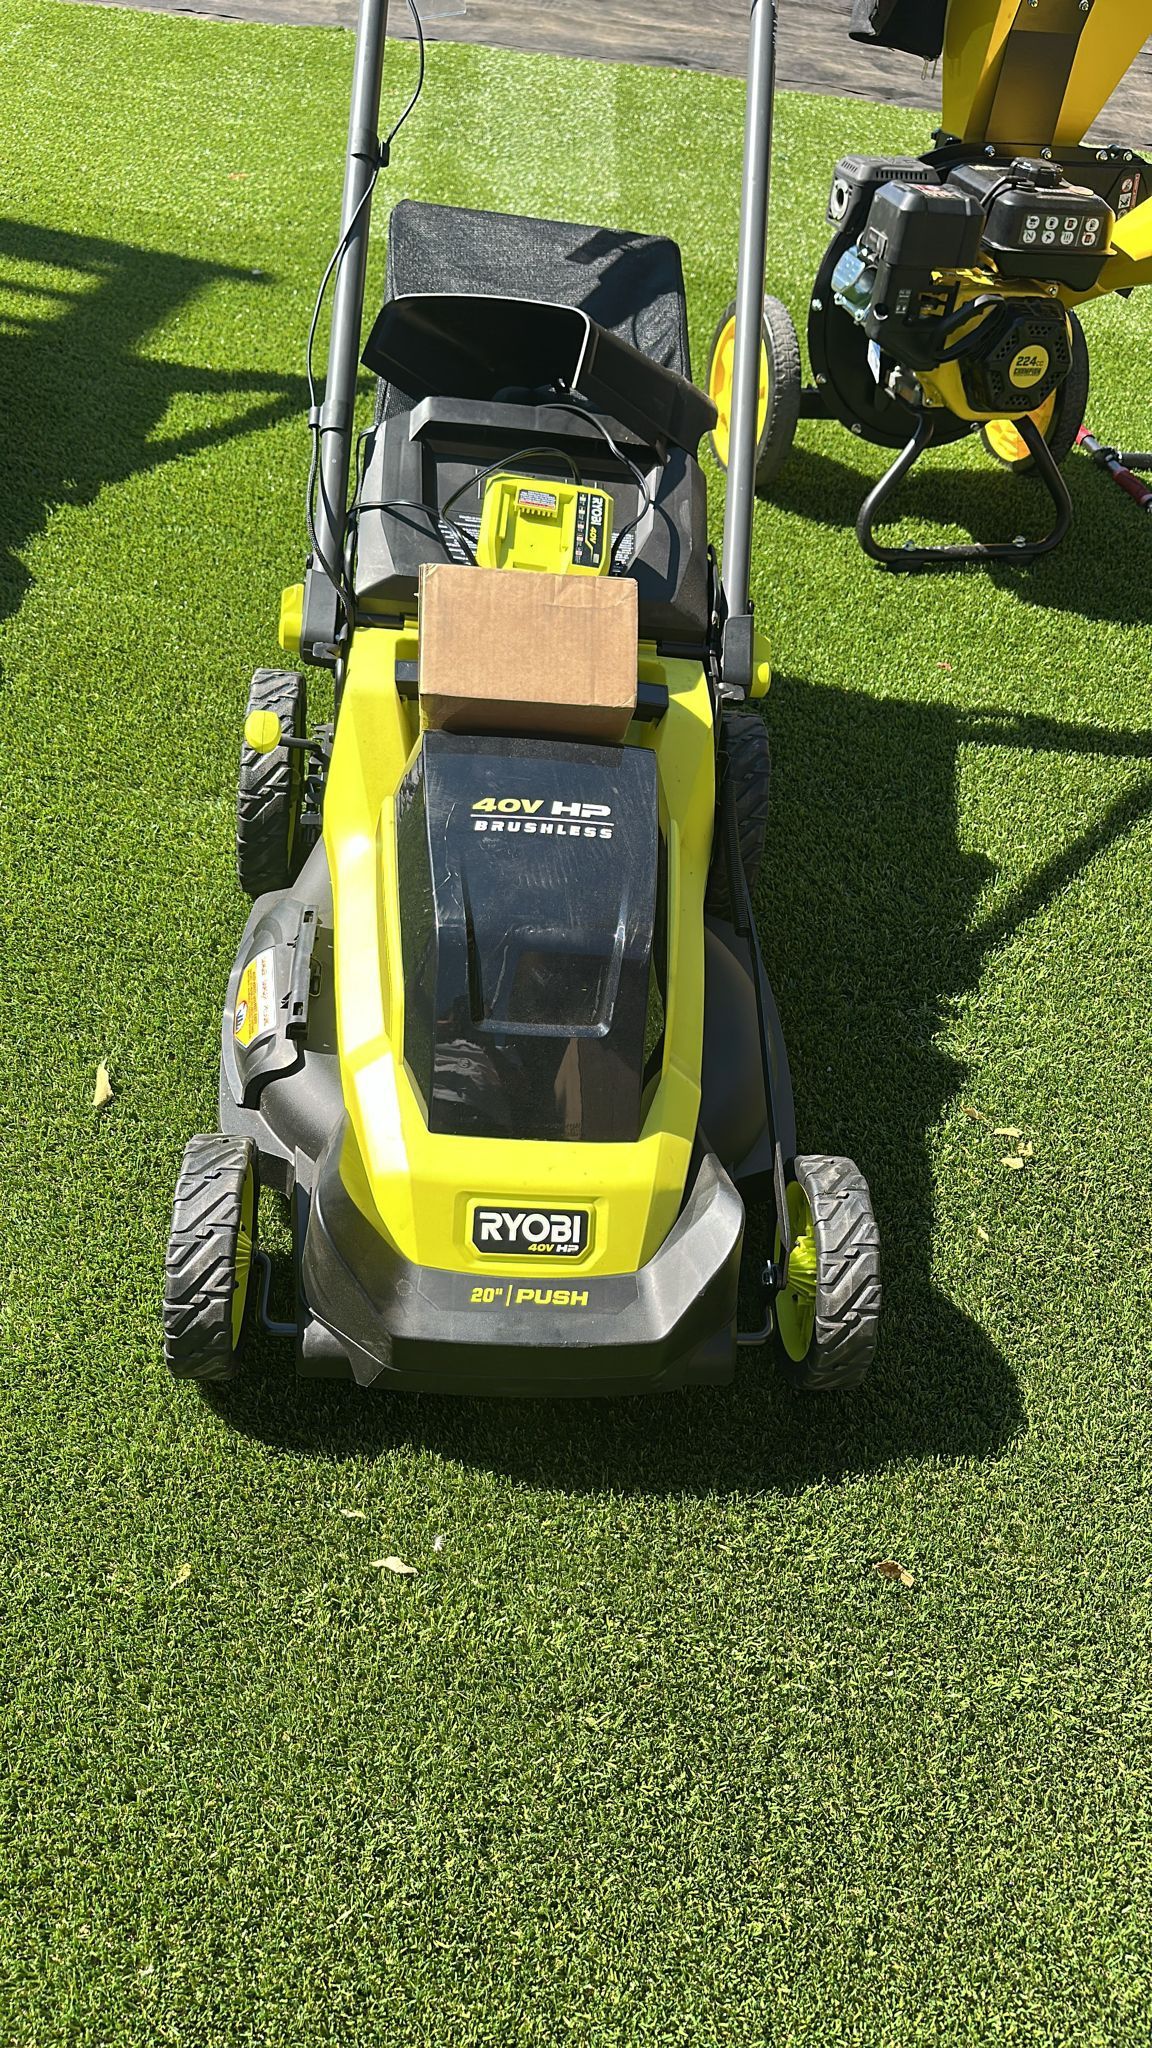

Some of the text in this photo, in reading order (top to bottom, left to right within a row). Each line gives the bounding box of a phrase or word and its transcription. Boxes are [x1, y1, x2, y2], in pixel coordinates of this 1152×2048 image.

[589, 497, 603, 545] RYOBI 40V
[472, 797, 611, 818] 40V HP
[474, 820, 613, 839] BRUSHLESS
[479, 1211, 581, 1243] RYOBI
[527, 1243, 580, 1253] 40V HP
[470, 1287, 589, 1306] 20" PUSH
